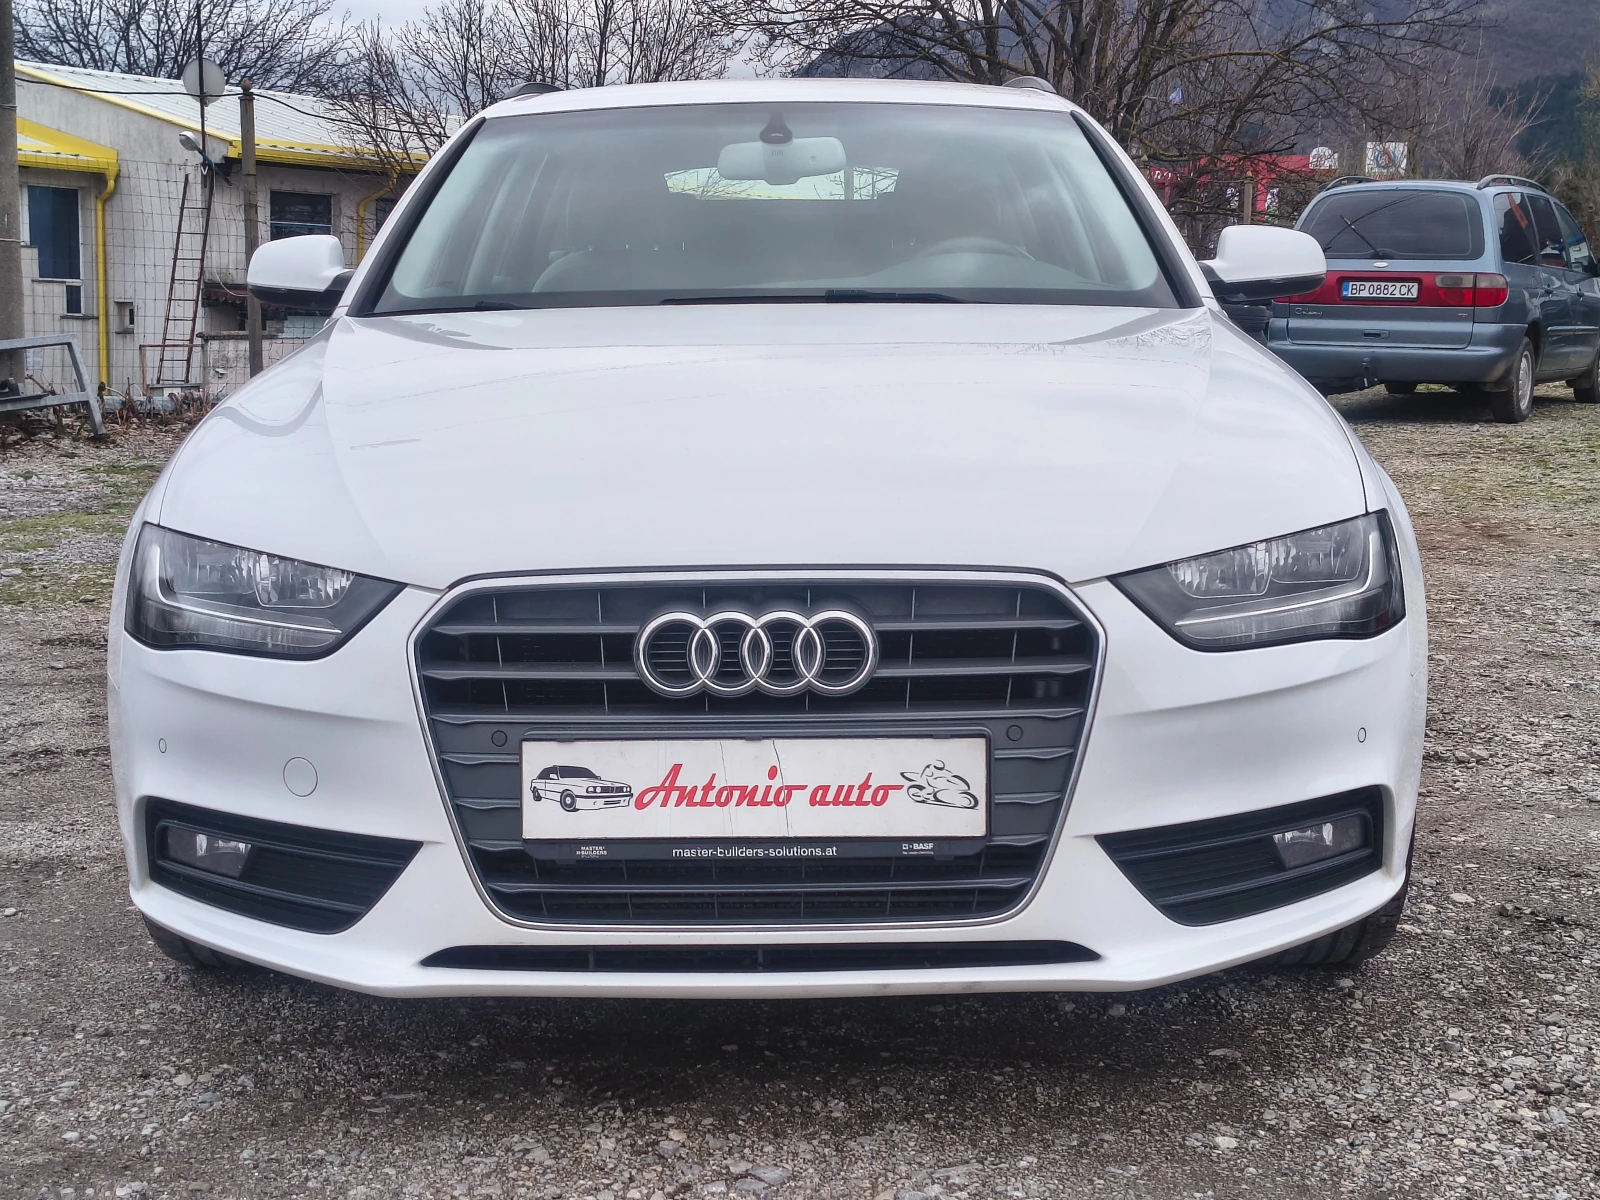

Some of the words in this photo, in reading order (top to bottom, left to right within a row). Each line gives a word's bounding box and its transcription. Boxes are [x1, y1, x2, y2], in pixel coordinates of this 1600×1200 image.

[1350, 283, 1366, 296] BP
[1368, 283, 1397, 296] 0882
[1399, 284, 1415, 297] CK
[634, 763, 808, 811] Antonio
[809, 772, 904, 807] auto
[672, 846, 838, 857] master-builders-solutions.at
[913, 842, 934, 850] BASF
